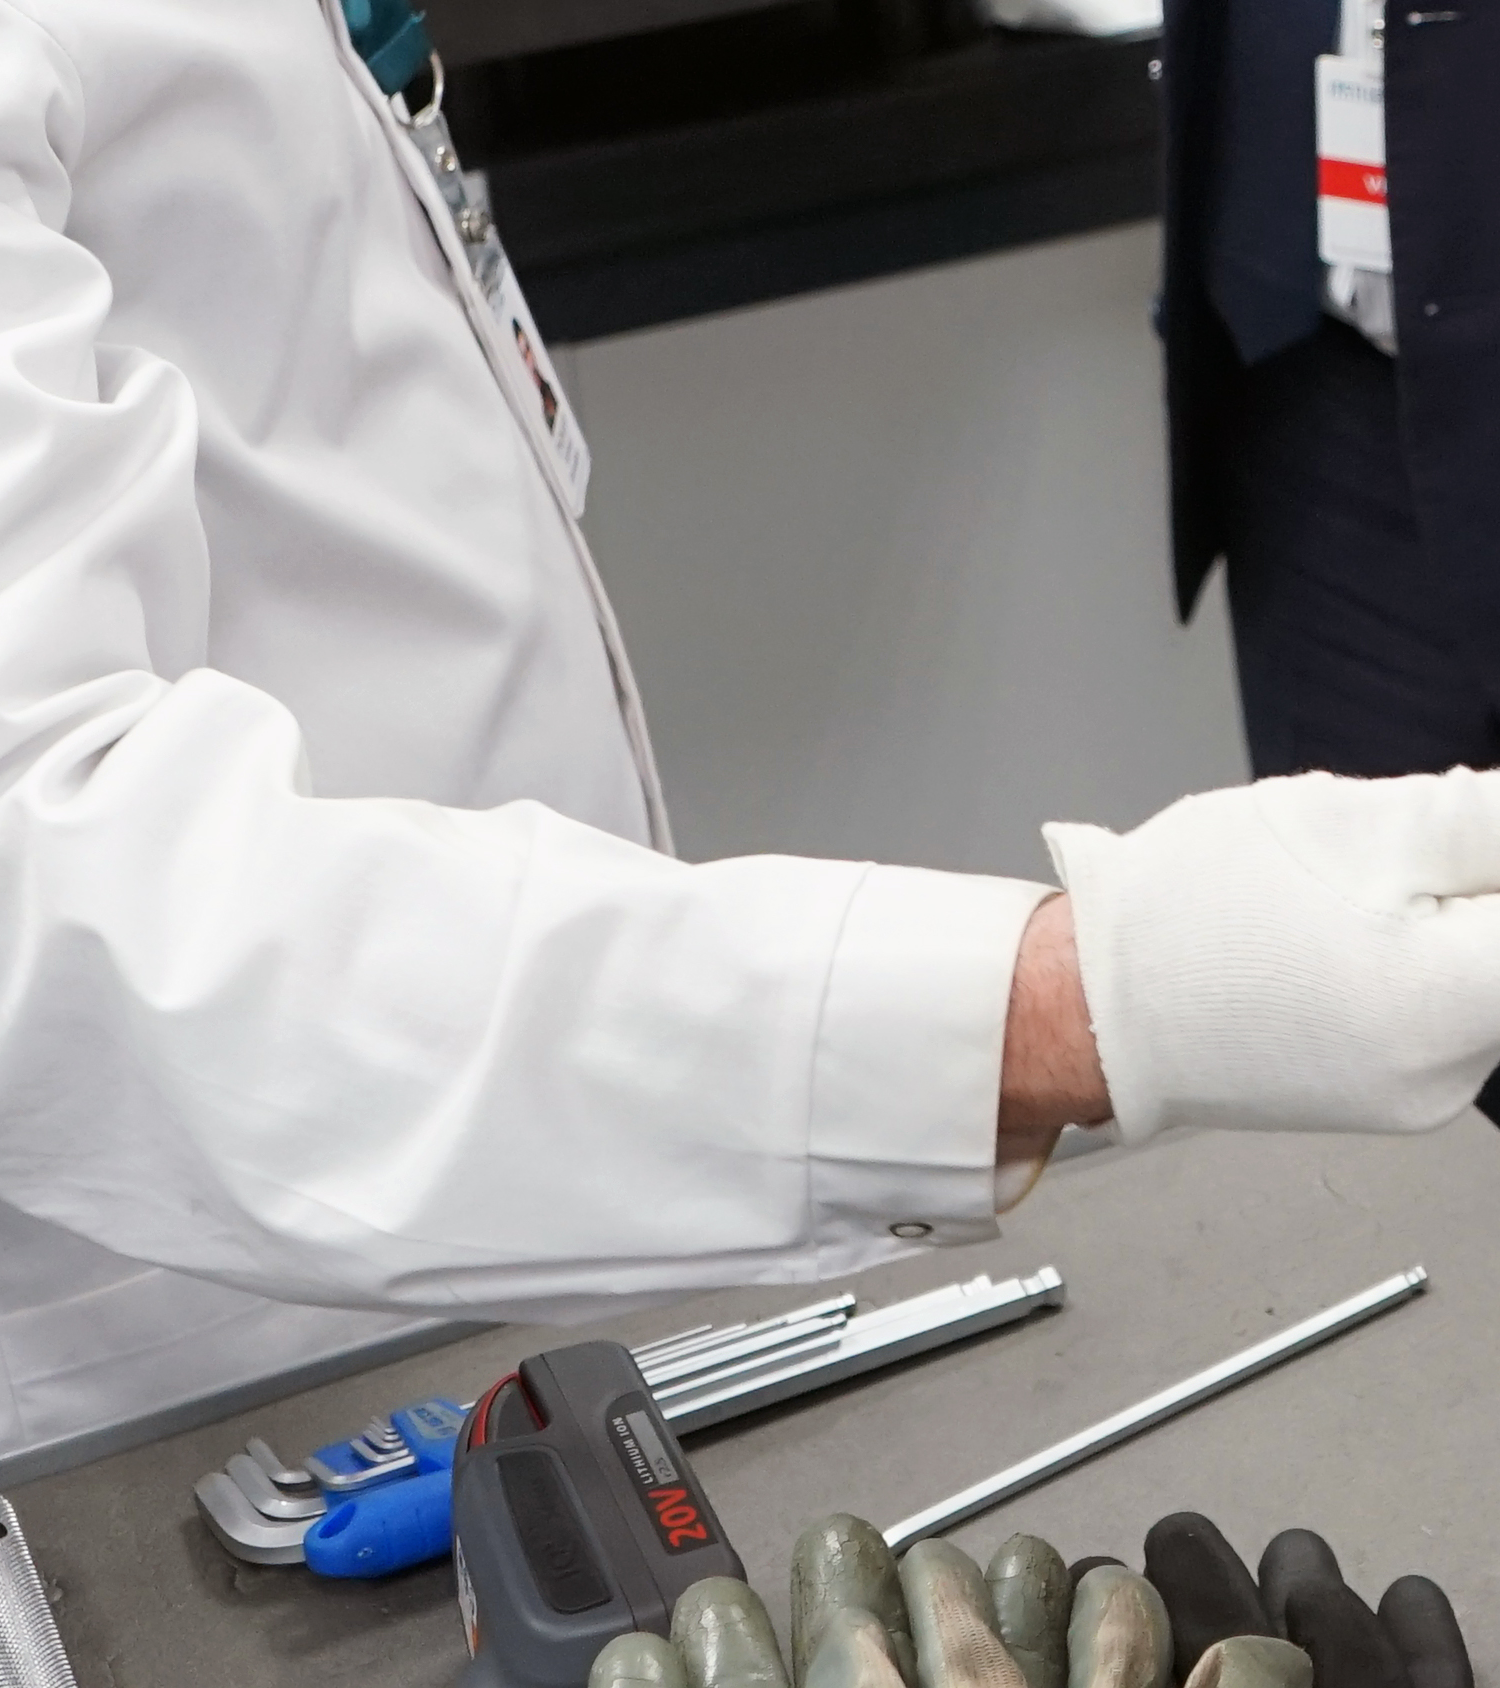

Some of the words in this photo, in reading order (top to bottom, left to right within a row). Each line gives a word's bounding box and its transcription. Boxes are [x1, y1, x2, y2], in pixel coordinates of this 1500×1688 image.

[612, 1417, 629, 1437] ION
[623, 1438, 654, 1484] LITHIUM
[648, 1489, 707, 1547] 20V
